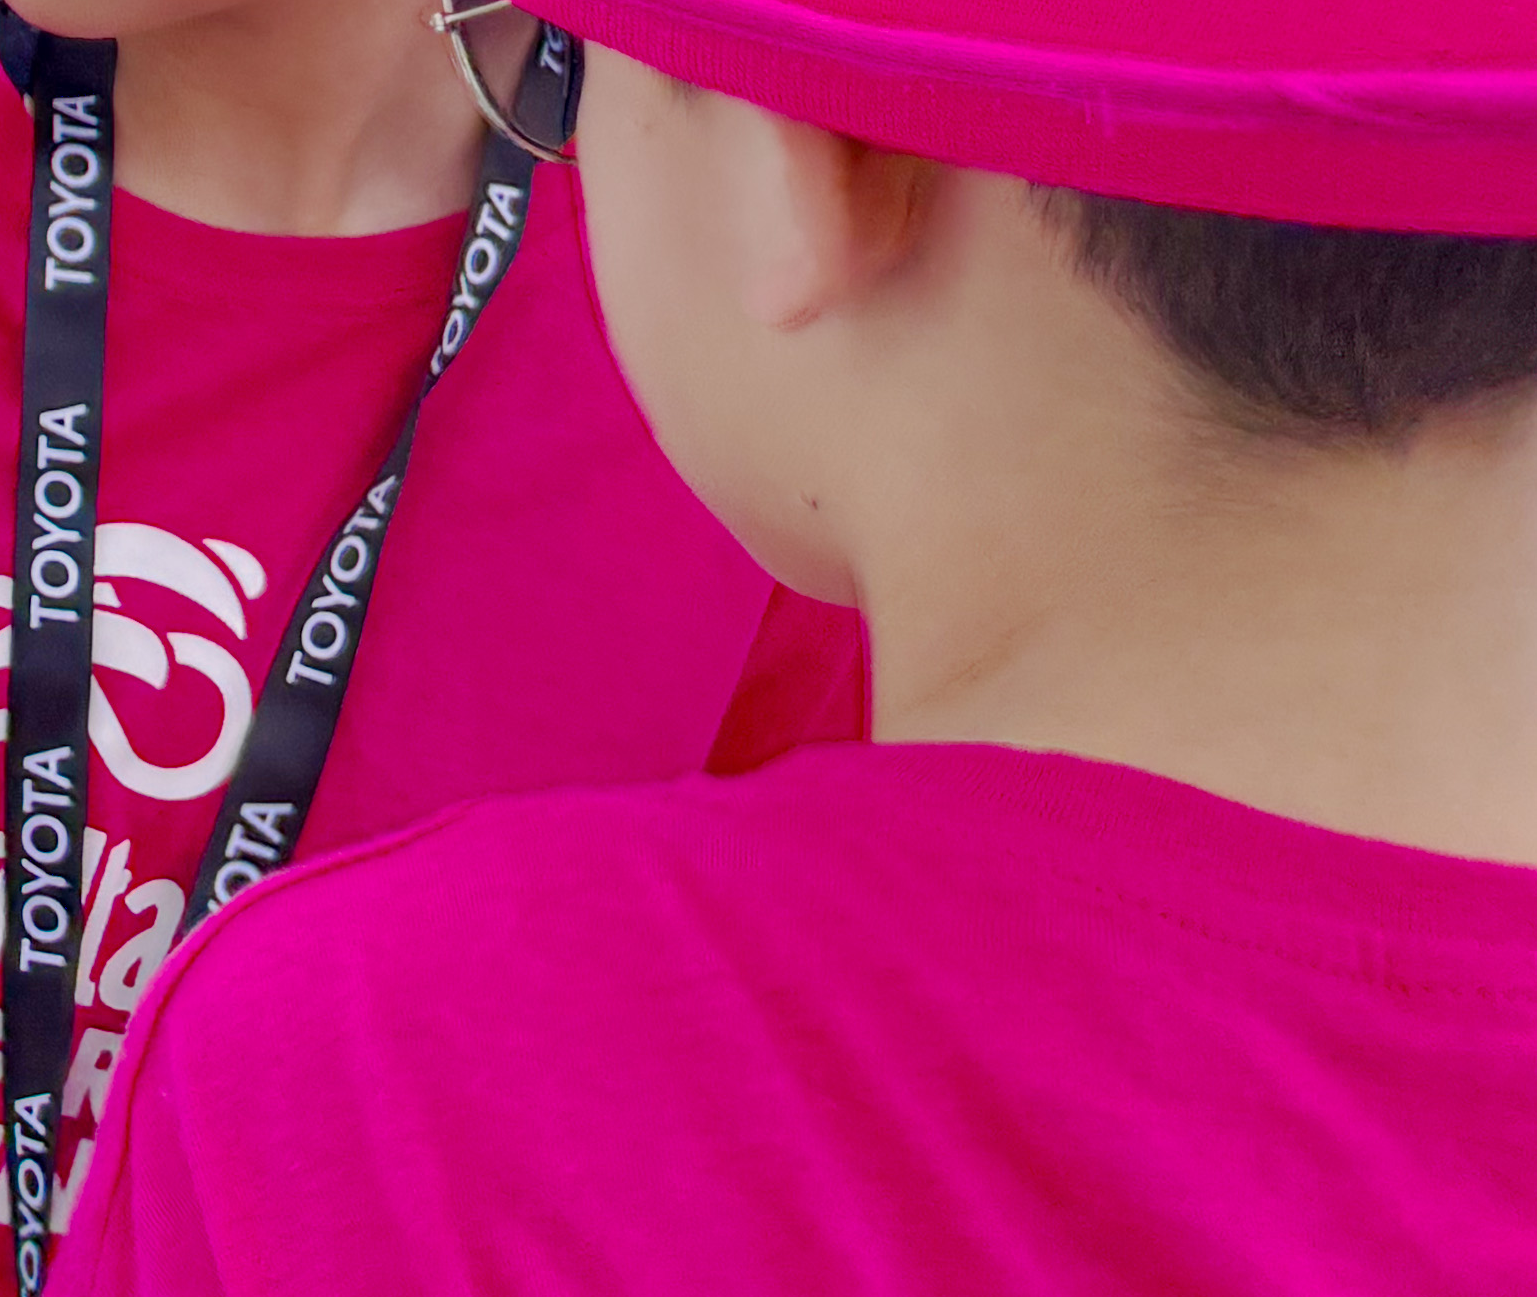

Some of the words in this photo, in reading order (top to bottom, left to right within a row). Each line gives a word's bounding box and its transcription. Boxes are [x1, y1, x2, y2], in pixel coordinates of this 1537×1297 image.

[43, 92, 100, 292] TOYOTA
[28, 402, 91, 631] TOYOTA
[285, 474, 398, 687] TOYOTA
[19, 745, 75, 973] TOYOTA
[16, 1092, 53, 1297] OYOTA
